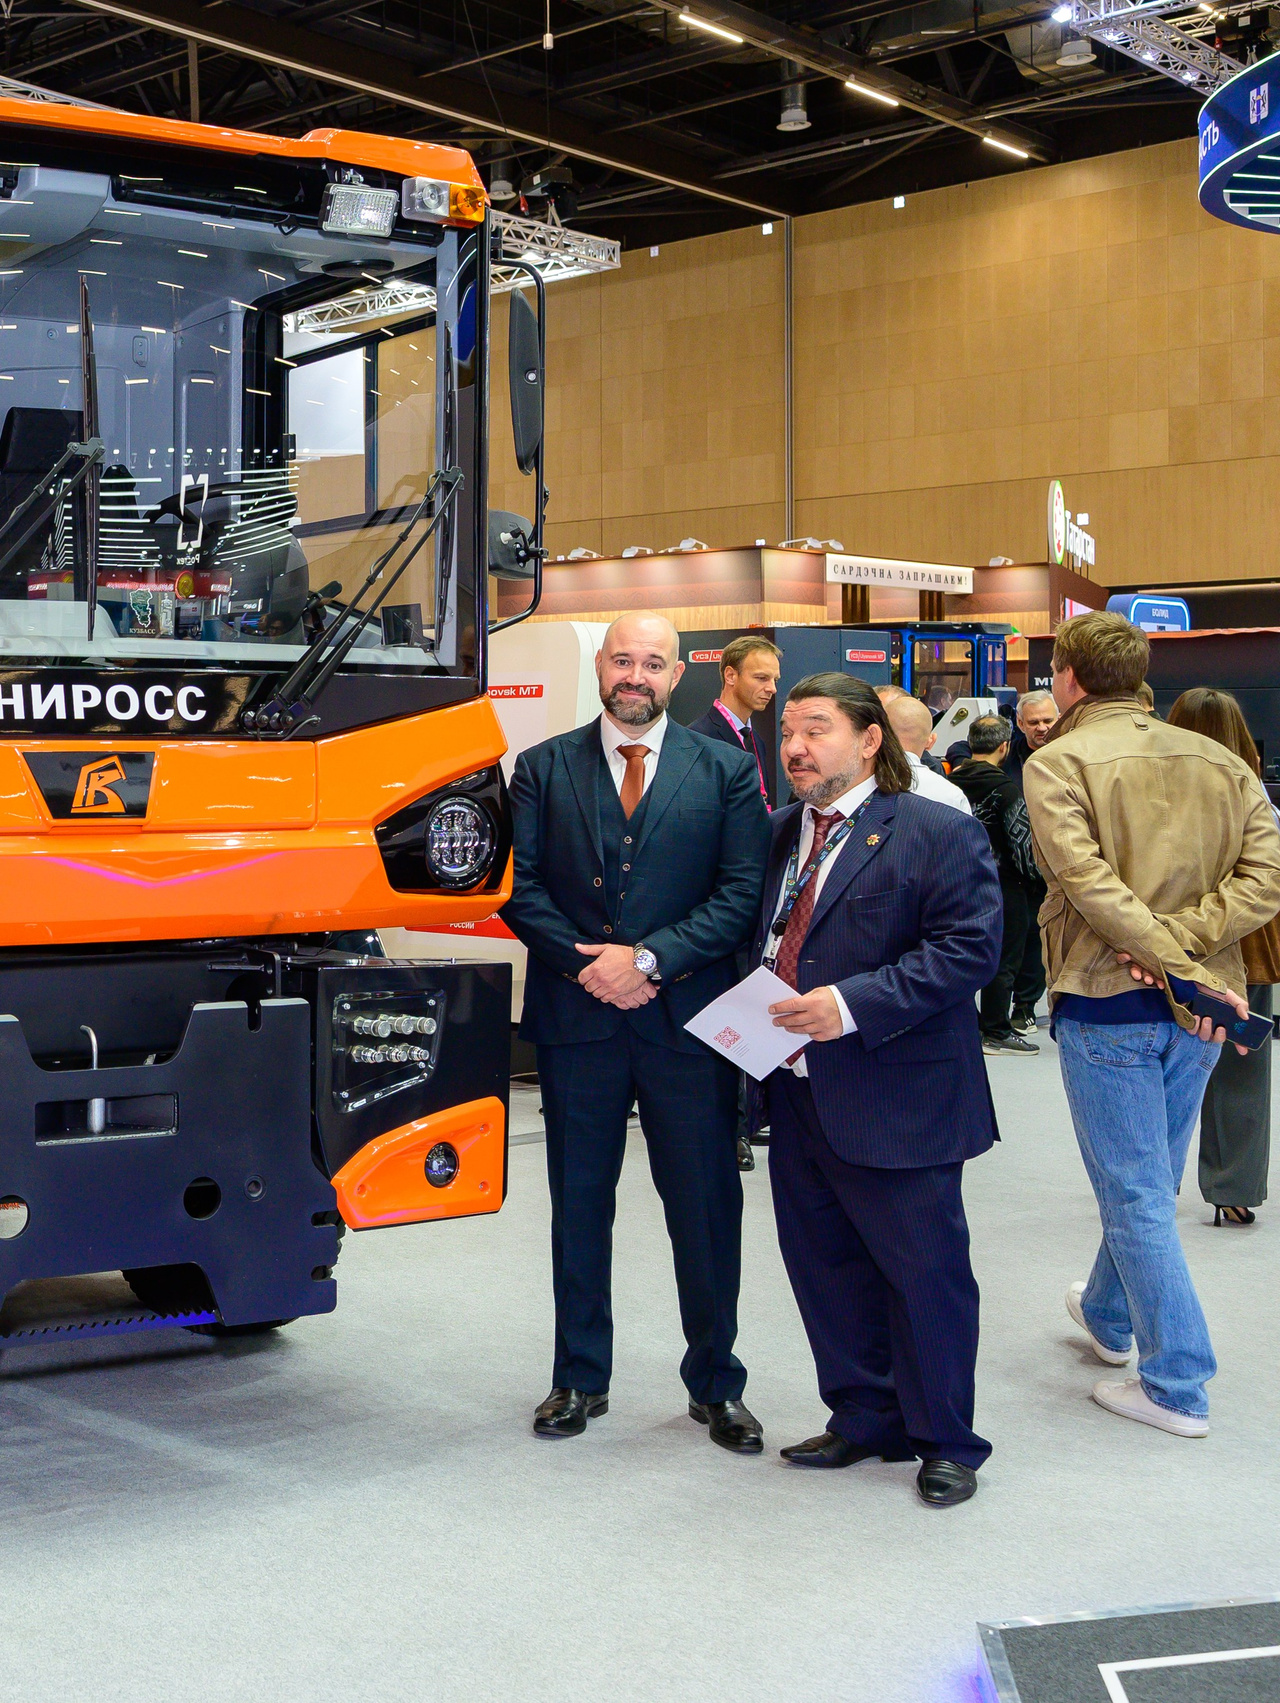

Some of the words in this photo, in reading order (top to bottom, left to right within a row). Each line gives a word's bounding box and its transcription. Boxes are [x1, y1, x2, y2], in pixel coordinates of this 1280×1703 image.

[833, 564, 893, 580] САРДЭЧНА
[899, 570, 967, 586] ЗАПРАШАЕМ!
[519, 686, 538, 696] MT
